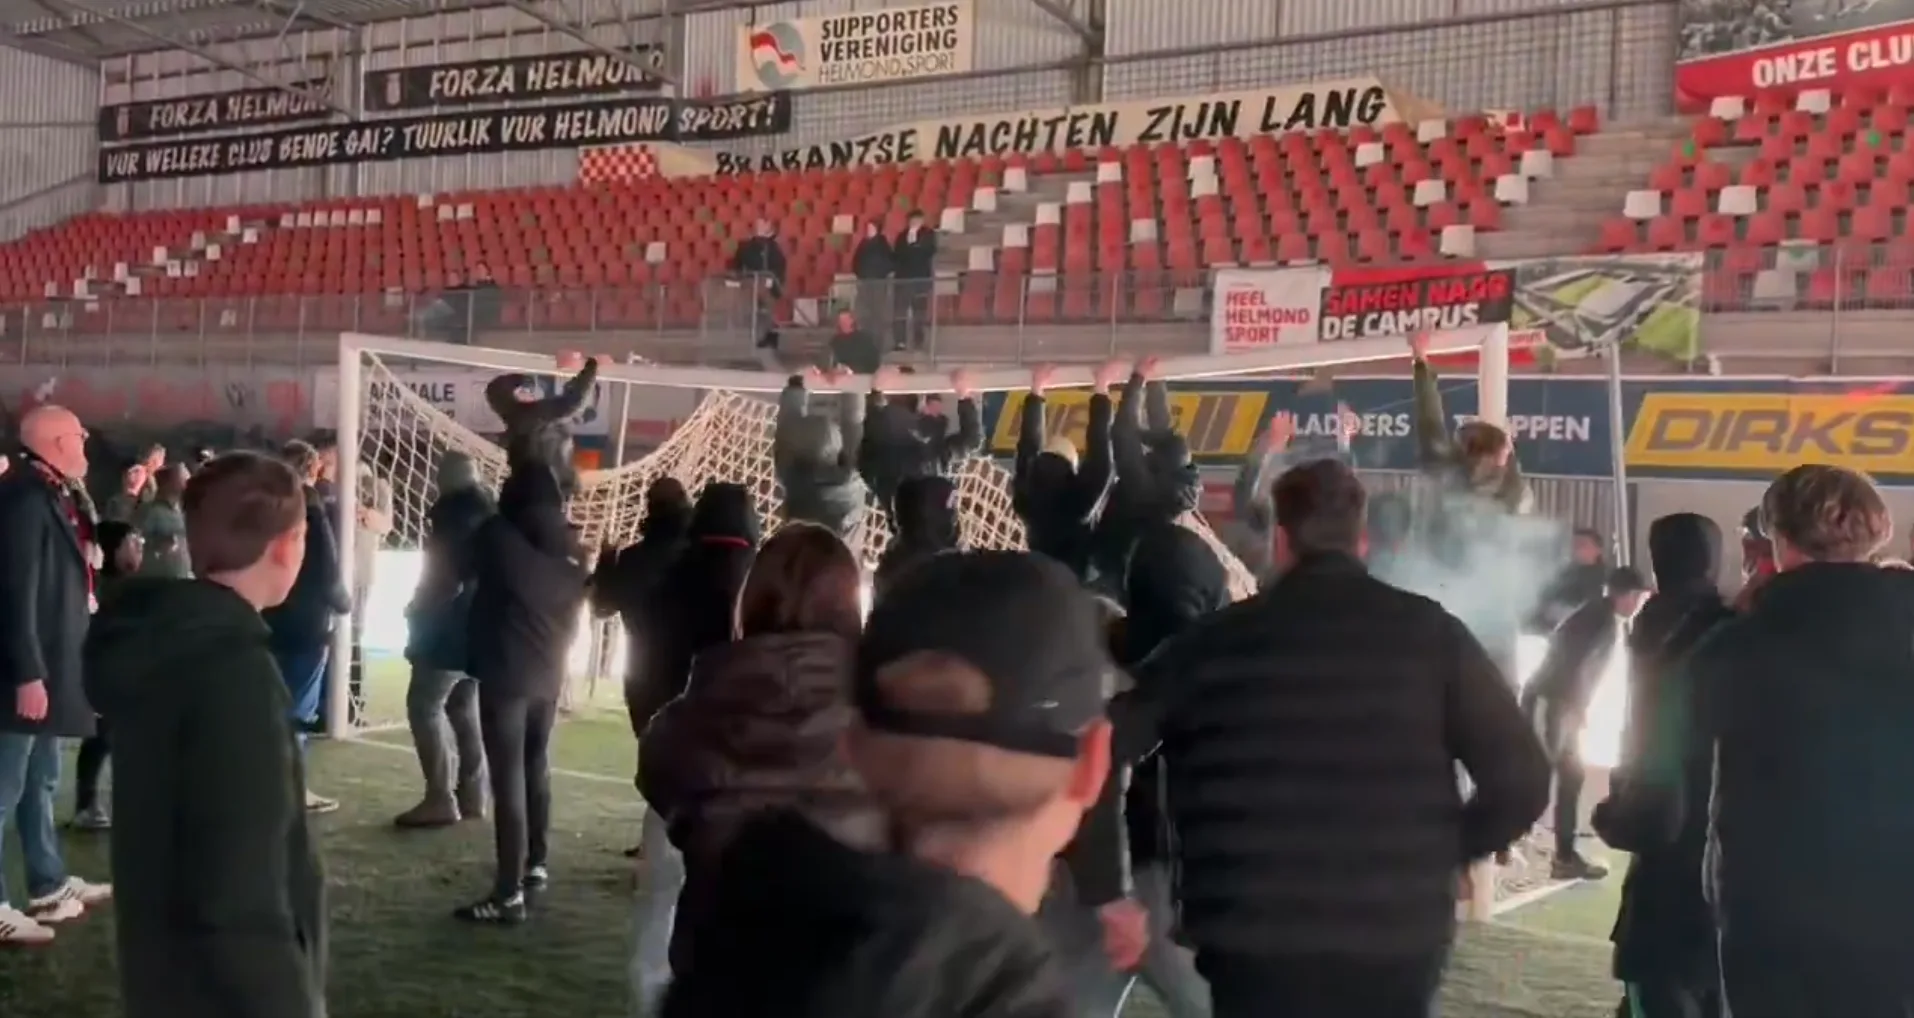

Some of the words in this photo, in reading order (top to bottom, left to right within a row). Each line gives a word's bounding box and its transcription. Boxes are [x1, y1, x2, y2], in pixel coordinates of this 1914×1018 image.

[821, 5, 958, 40] SUPPORTERS
[820, 29, 957, 62] VERENIGING
[1752, 47, 1838, 88] ONZE
[1847, 34, 1914, 71] CLU
[429, 64, 516, 98] FORZA
[149, 97, 219, 129] FORZA
[226, 86, 331, 120] HELMON
[934, 110, 1118, 159] NACHTEN
[1137, 100, 1241, 141] ZIJN
[1260, 86, 1387, 131] LANG
[106, 152, 140, 177] VUR
[145, 143, 220, 173] WELLEKE
[279, 131, 340, 162] BENDE
[345, 126, 395, 157] GAI?
[402, 118, 492, 151] TUURLIK
[500, 114, 548, 144] VUR
[553, 105, 671, 140] HELMOND
[679, 97, 777, 133] SPORT!
[1226, 290, 1267, 307] HEEL
[1328, 285, 1420, 314] SAMEN
[1226, 308, 1310, 324] HELMOND
[1322, 314, 1358, 340] DE
[1363, 302, 1480, 337] CAMPUS
[1225, 326, 1279, 343] SPORT
[1453, 414, 1590, 441] TPPEN
[1645, 408, 1914, 455] DIRKS
